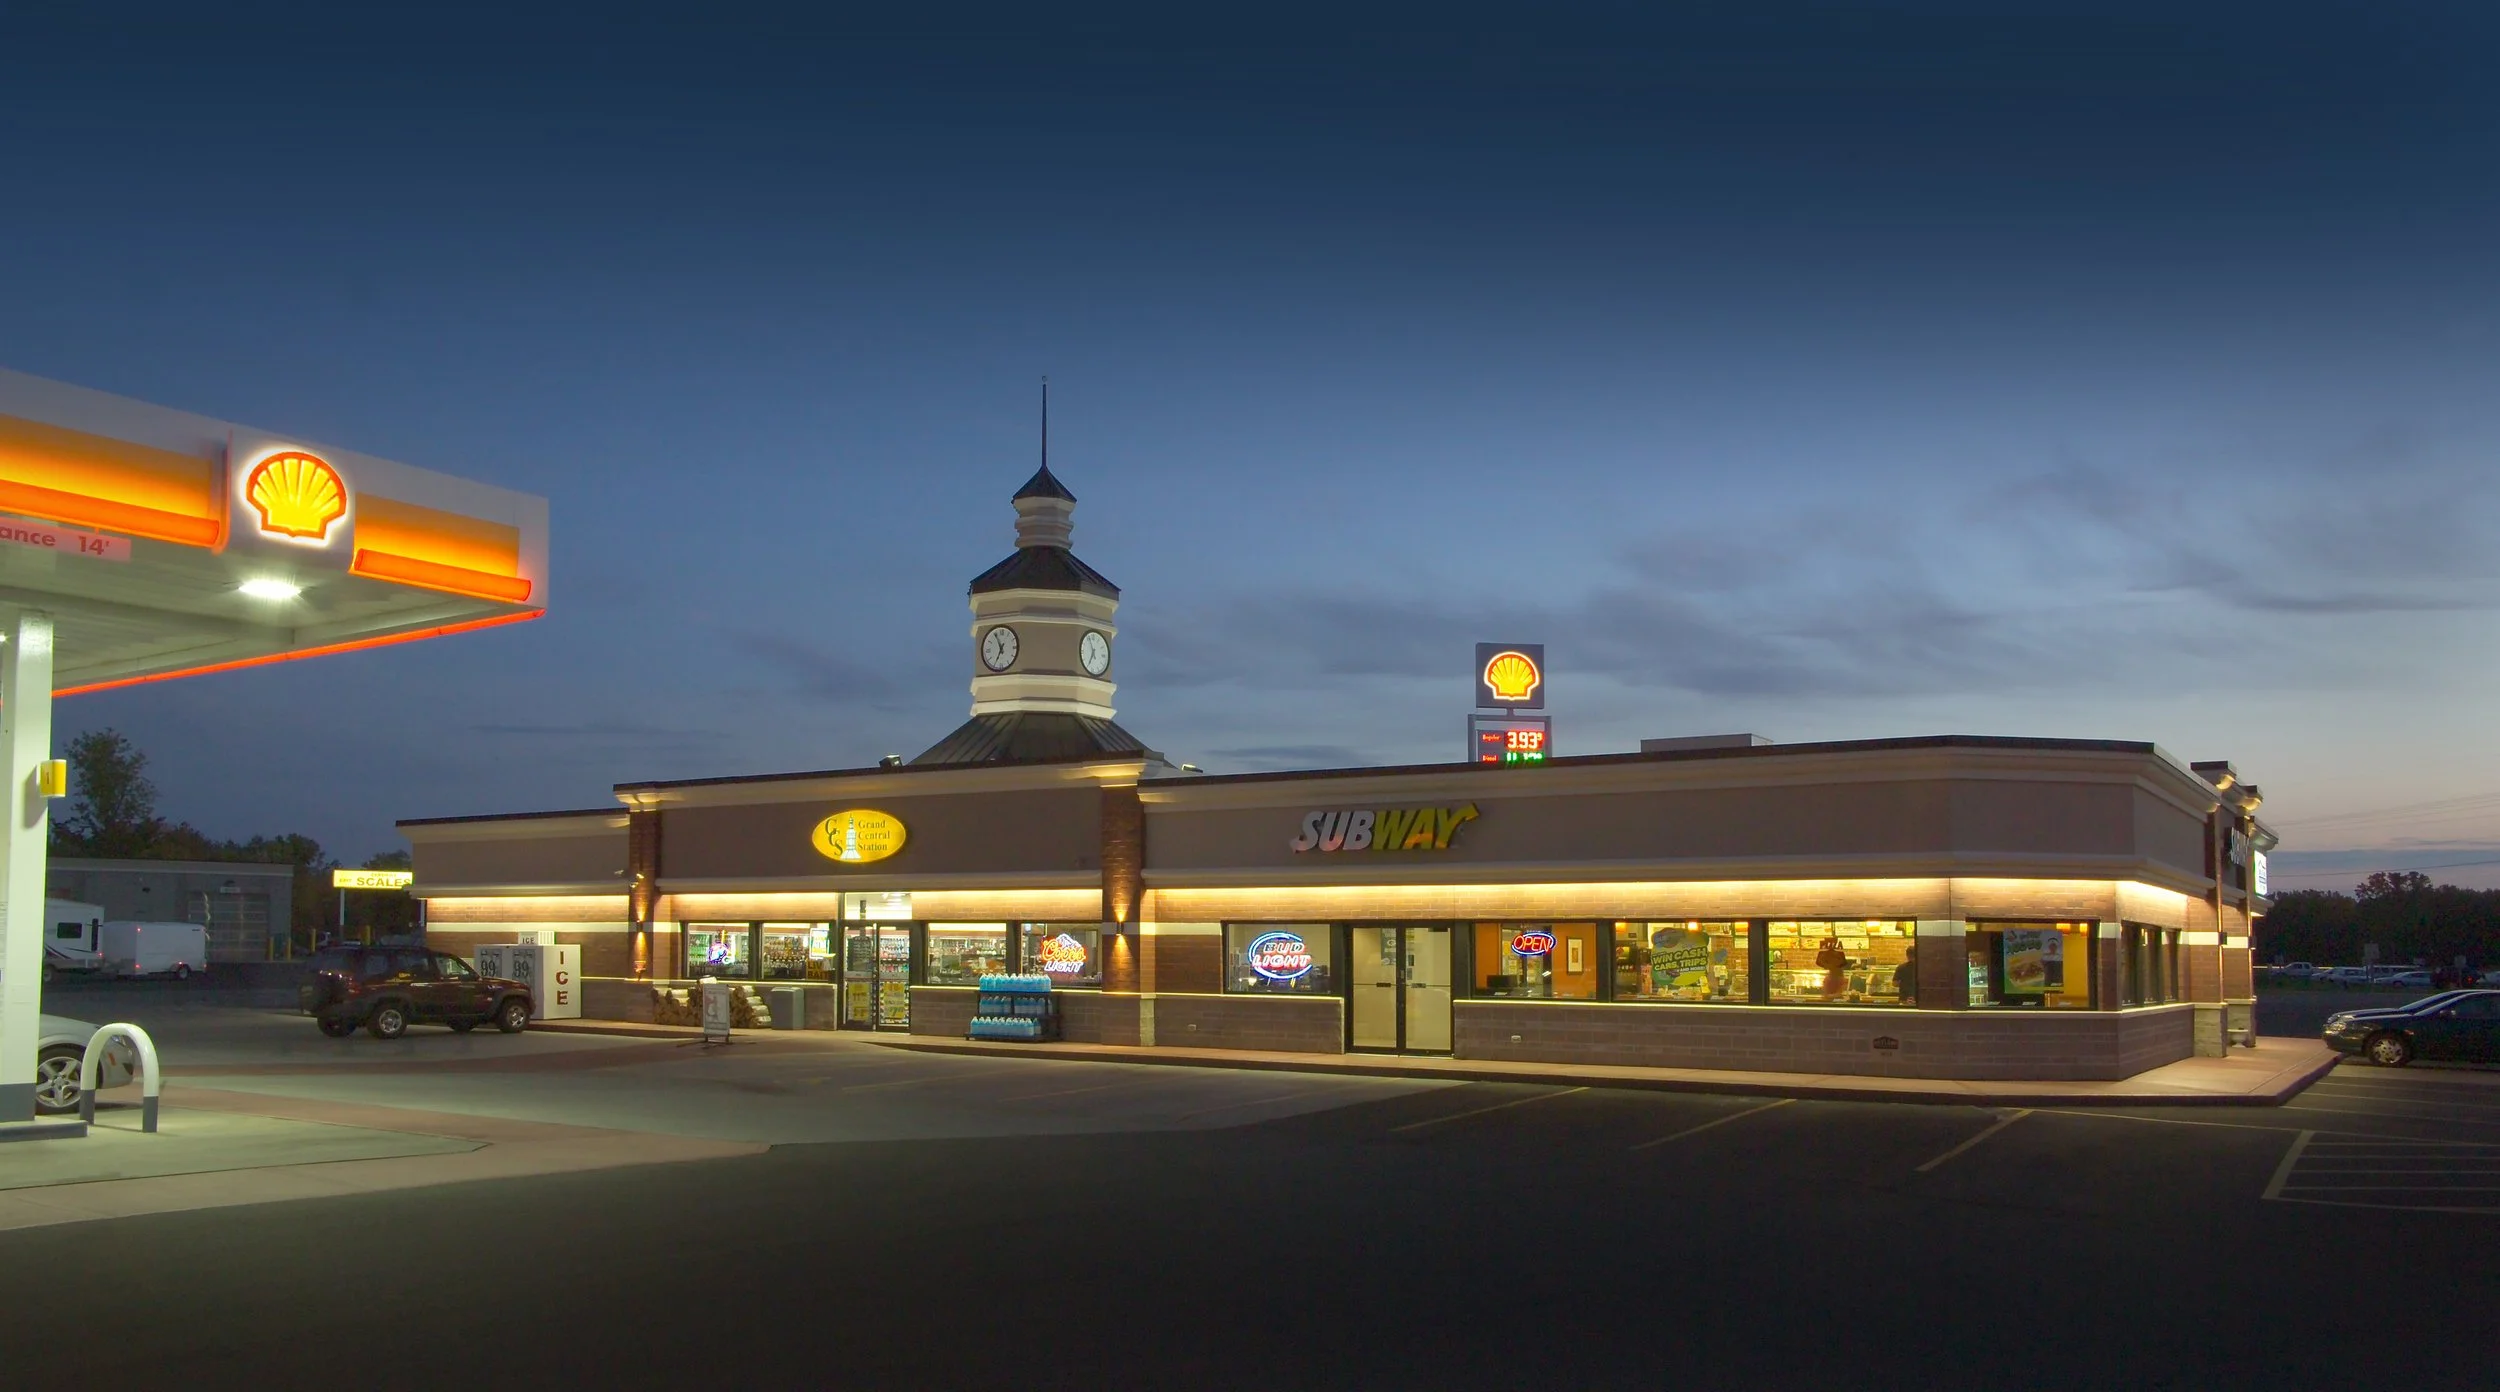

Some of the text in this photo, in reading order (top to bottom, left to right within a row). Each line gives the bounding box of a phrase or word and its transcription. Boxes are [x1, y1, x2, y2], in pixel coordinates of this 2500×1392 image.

[858, 820, 886, 829] Grand
[1289, 803, 1480, 853] SUBWAY
[858, 831, 891, 840] Central
[858, 842, 888, 851] Station
[356, 877, 411, 887] SCALES
[1263, 942, 1305, 954] BUD
[1513, 935, 1551, 952] OPEN
[1042, 939, 1086, 961] Coors
[1252, 954, 1312, 968] LIGHT
[1653, 953, 1674, 964] WIN
[1680, 957, 1707, 967] TRIPS
[1044, 960, 1084, 973] LIGHT
[555, 951, 569, 1006] ICE
